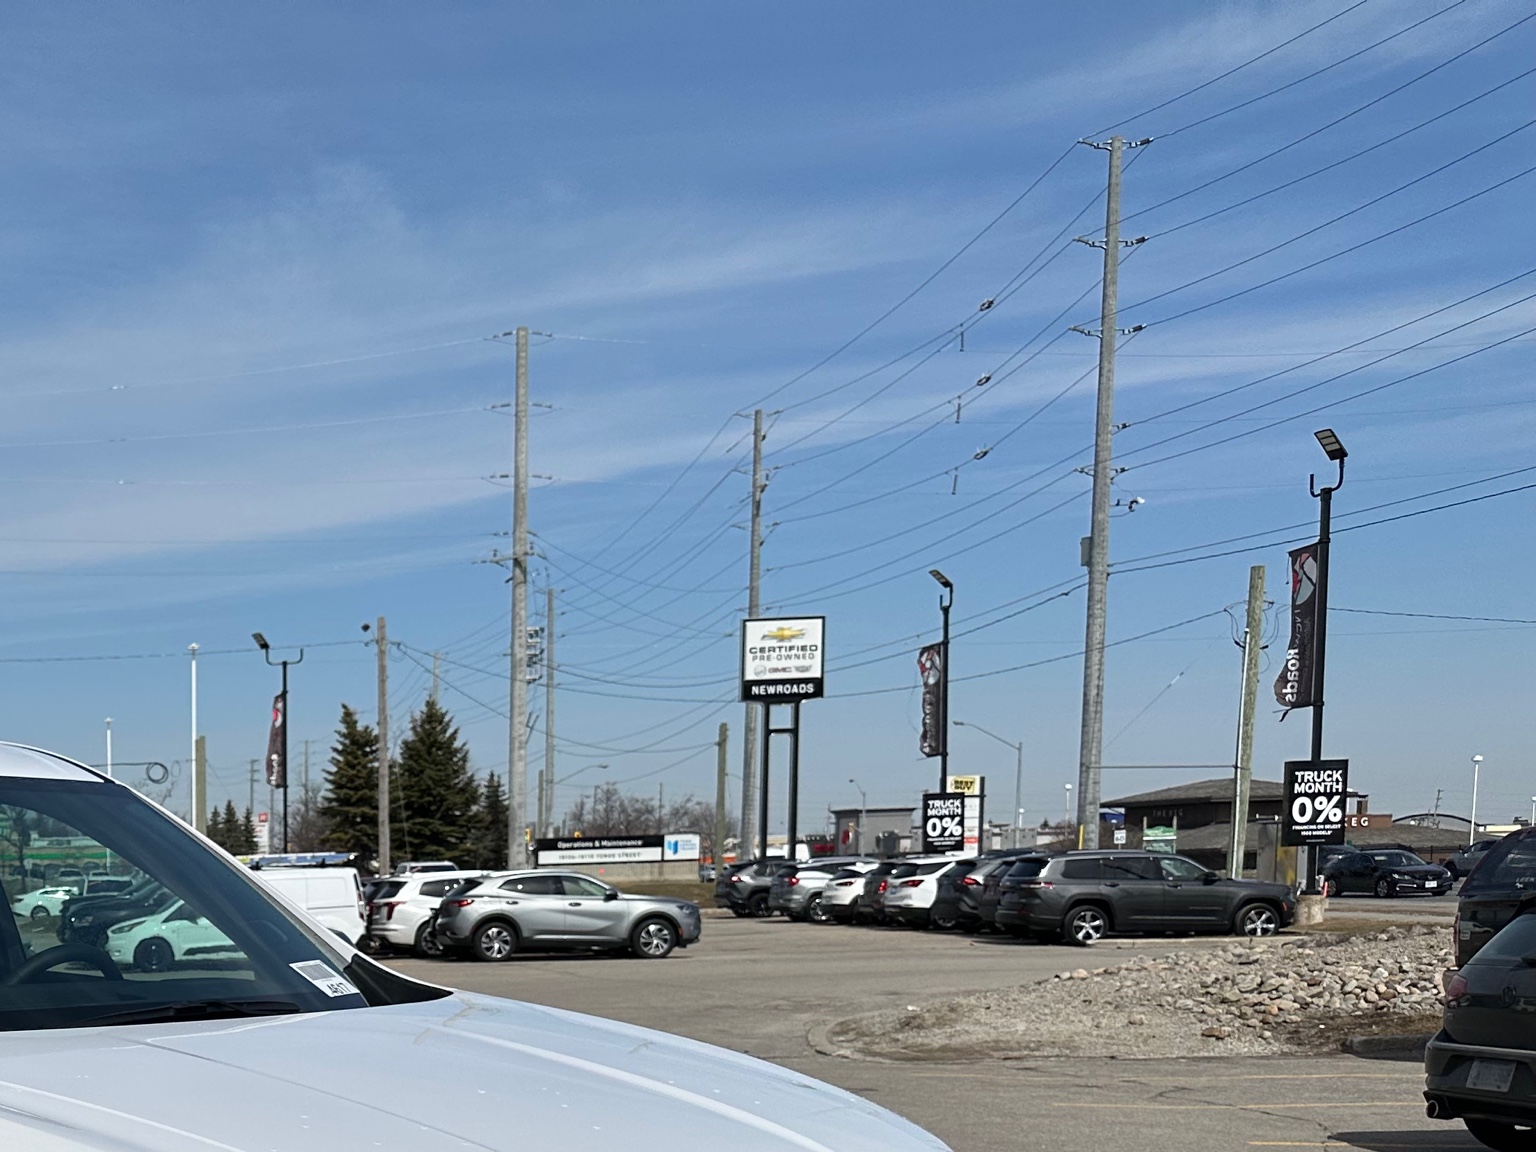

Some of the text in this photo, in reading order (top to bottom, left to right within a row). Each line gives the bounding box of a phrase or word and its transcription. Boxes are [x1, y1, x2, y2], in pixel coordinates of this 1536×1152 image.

[749, 644, 818, 655] CERTIFIED
[752, 653, 815, 662] PRE-OWNED
[751, 683, 814, 695] NEWROADS
[1294, 770, 1342, 783] TRUCK
[1294, 781, 1342, 794] MONTH
[927, 799, 961, 808] TRUCK
[1292, 795, 1342, 823] 0%
[927, 808, 961, 816] MONTH
[926, 816, 962, 837] 0%
[557, 841, 593, 849] Operations
